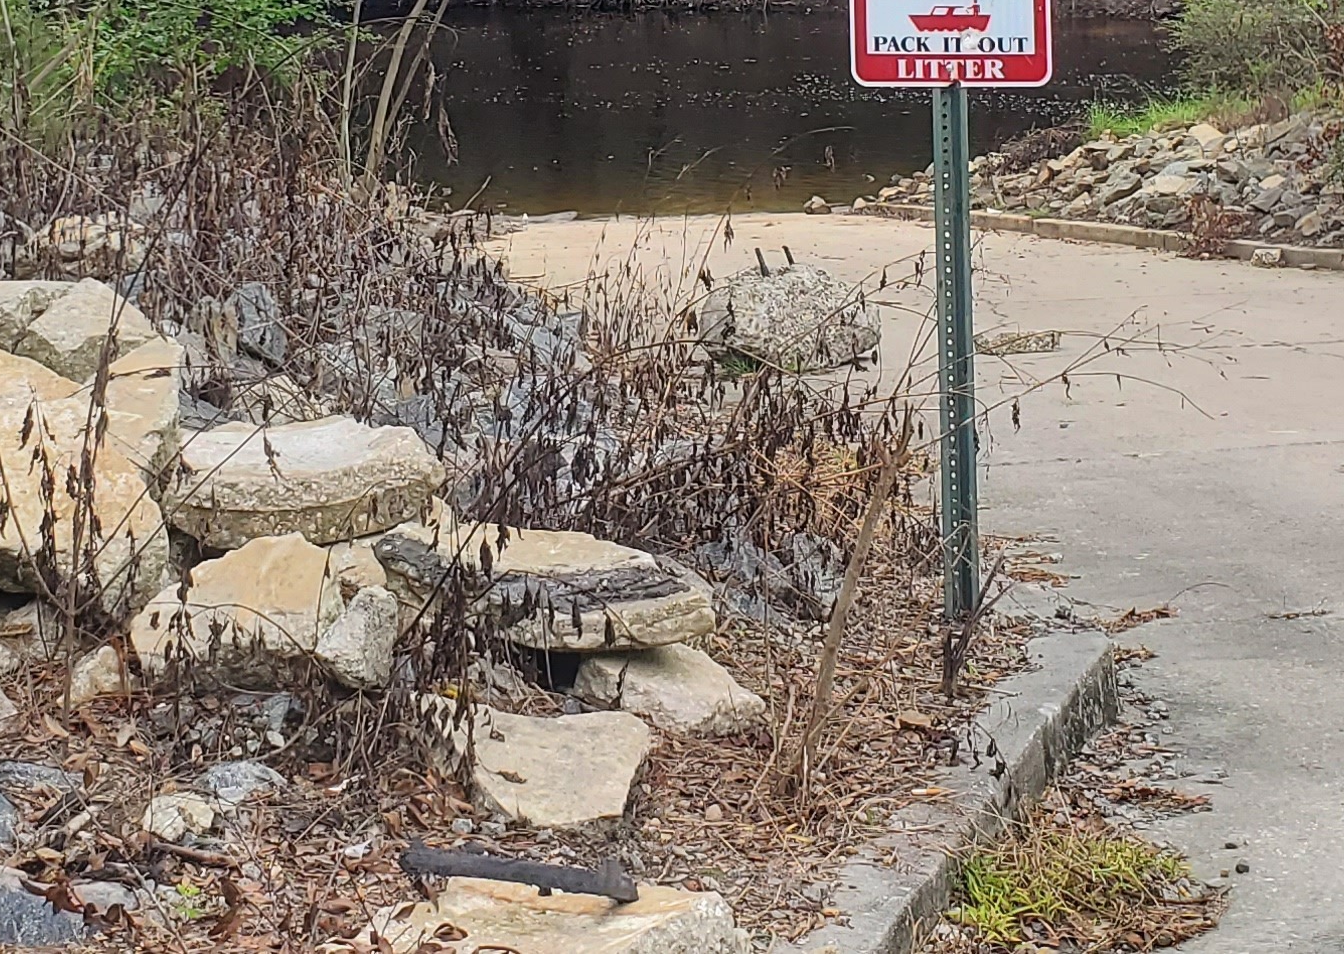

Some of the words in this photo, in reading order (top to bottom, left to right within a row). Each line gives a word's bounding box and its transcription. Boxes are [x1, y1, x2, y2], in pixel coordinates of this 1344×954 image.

[873, 36, 931, 53] PACK
[943, 36, 963, 53] IT
[977, 36, 1029, 53] OUT
[897, 58, 1005, 79] LITTER
